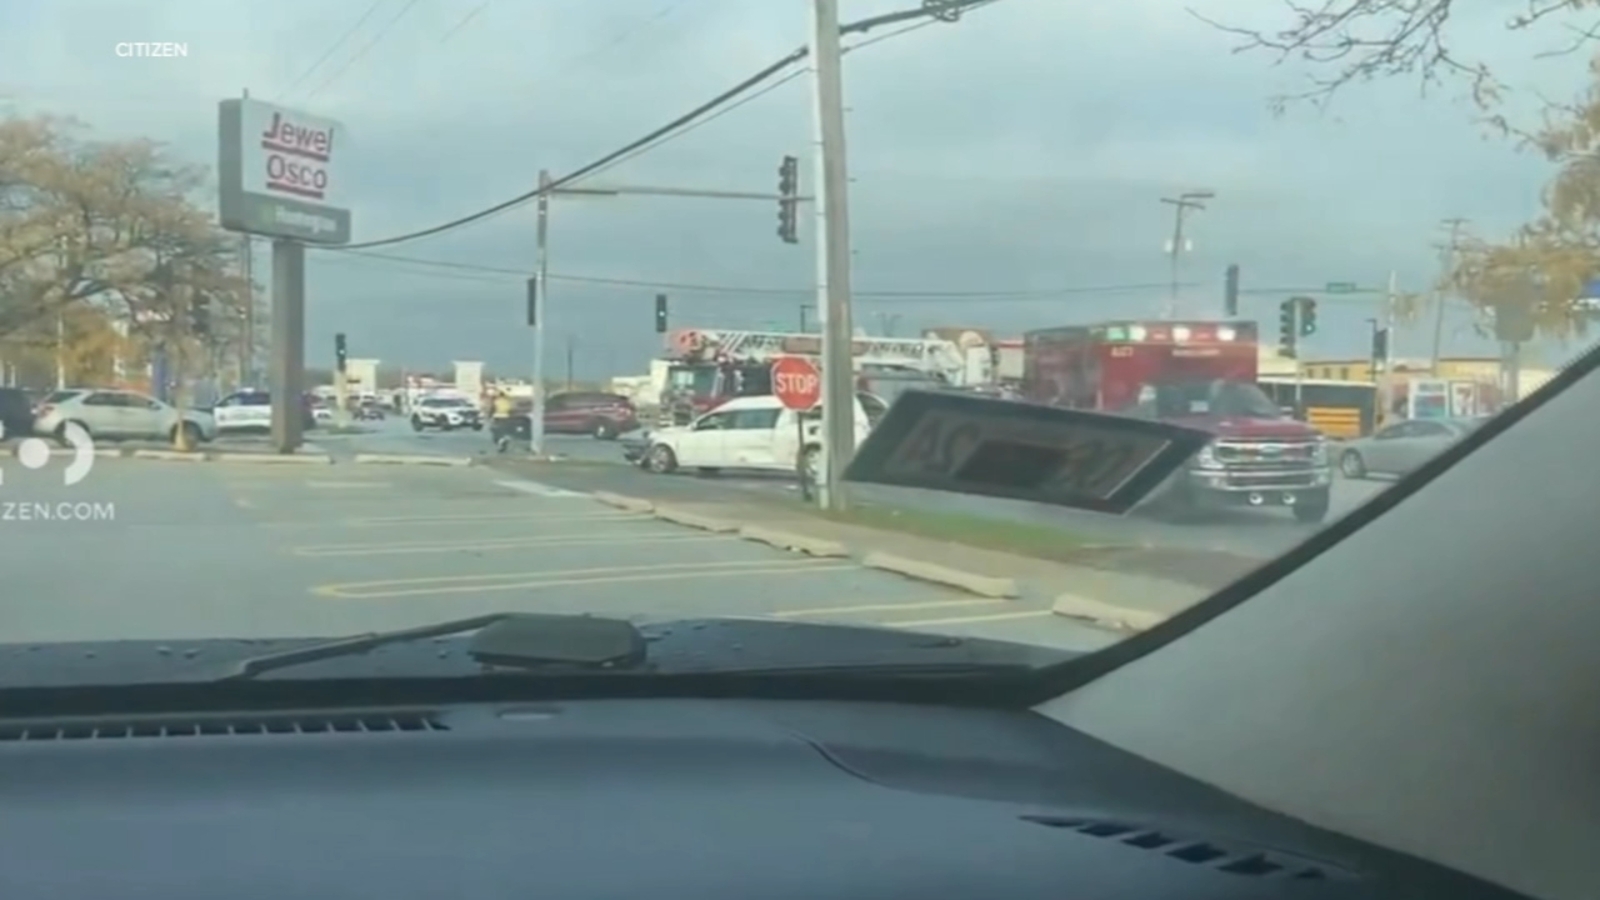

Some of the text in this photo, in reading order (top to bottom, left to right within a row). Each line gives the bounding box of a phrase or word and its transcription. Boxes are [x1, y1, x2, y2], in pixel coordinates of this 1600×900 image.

[262, 112, 334, 154] Jewel
[267, 154, 328, 190] Osco
[776, 373, 818, 395] STOP
